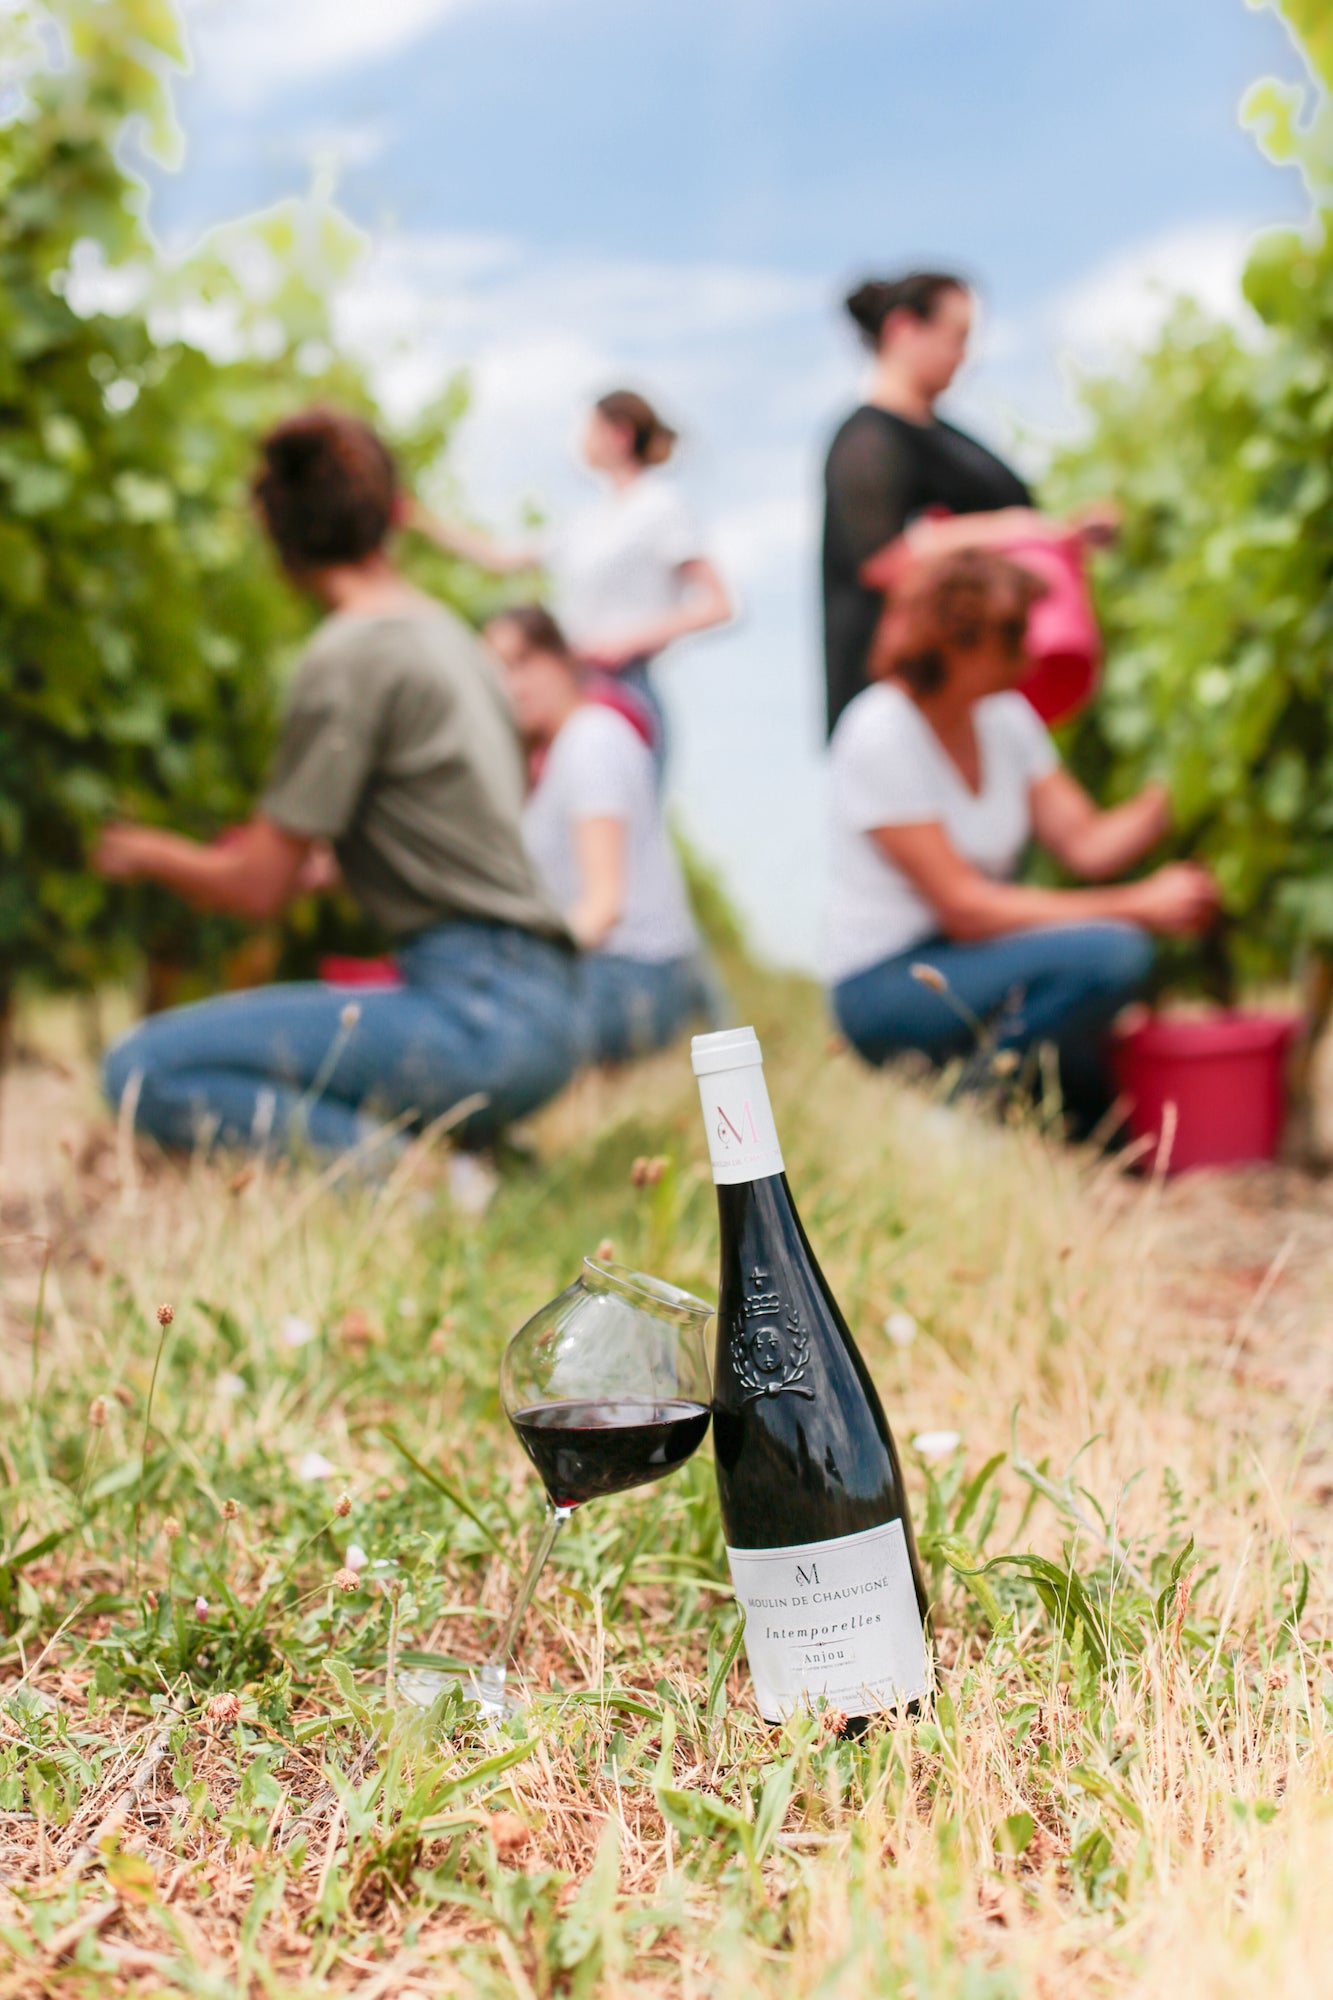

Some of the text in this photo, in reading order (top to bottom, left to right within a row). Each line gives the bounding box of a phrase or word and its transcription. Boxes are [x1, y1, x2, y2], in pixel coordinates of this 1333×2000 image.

[747, 1576, 889, 1608] MOULIN DE CHAUVIGNÉ
[766, 1614, 881, 1640] Intemporelles
[803, 1650, 845, 1664] Anjou
